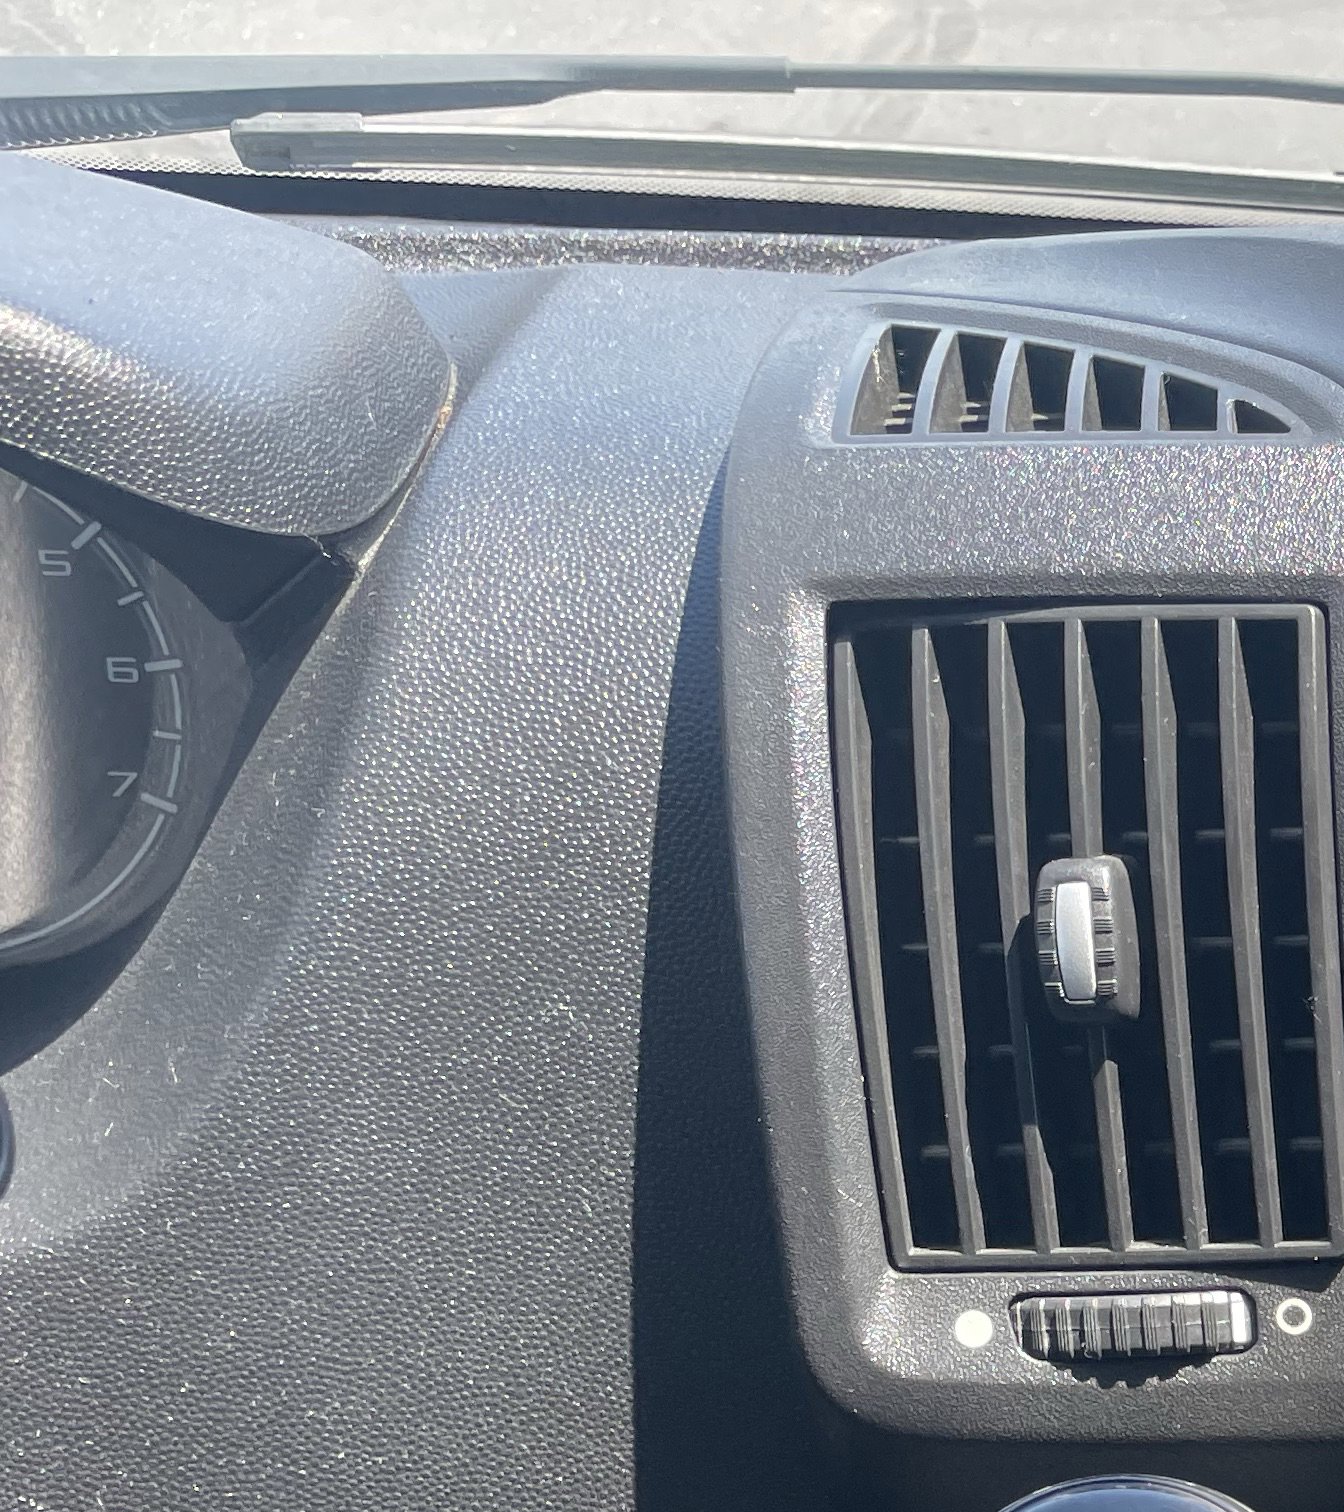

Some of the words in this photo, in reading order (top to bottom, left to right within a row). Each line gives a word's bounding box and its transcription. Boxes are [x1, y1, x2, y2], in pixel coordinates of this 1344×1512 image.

[38, 549, 72, 577] 5
[106, 657, 138, 683] 6
[107, 771, 138, 798] 7
